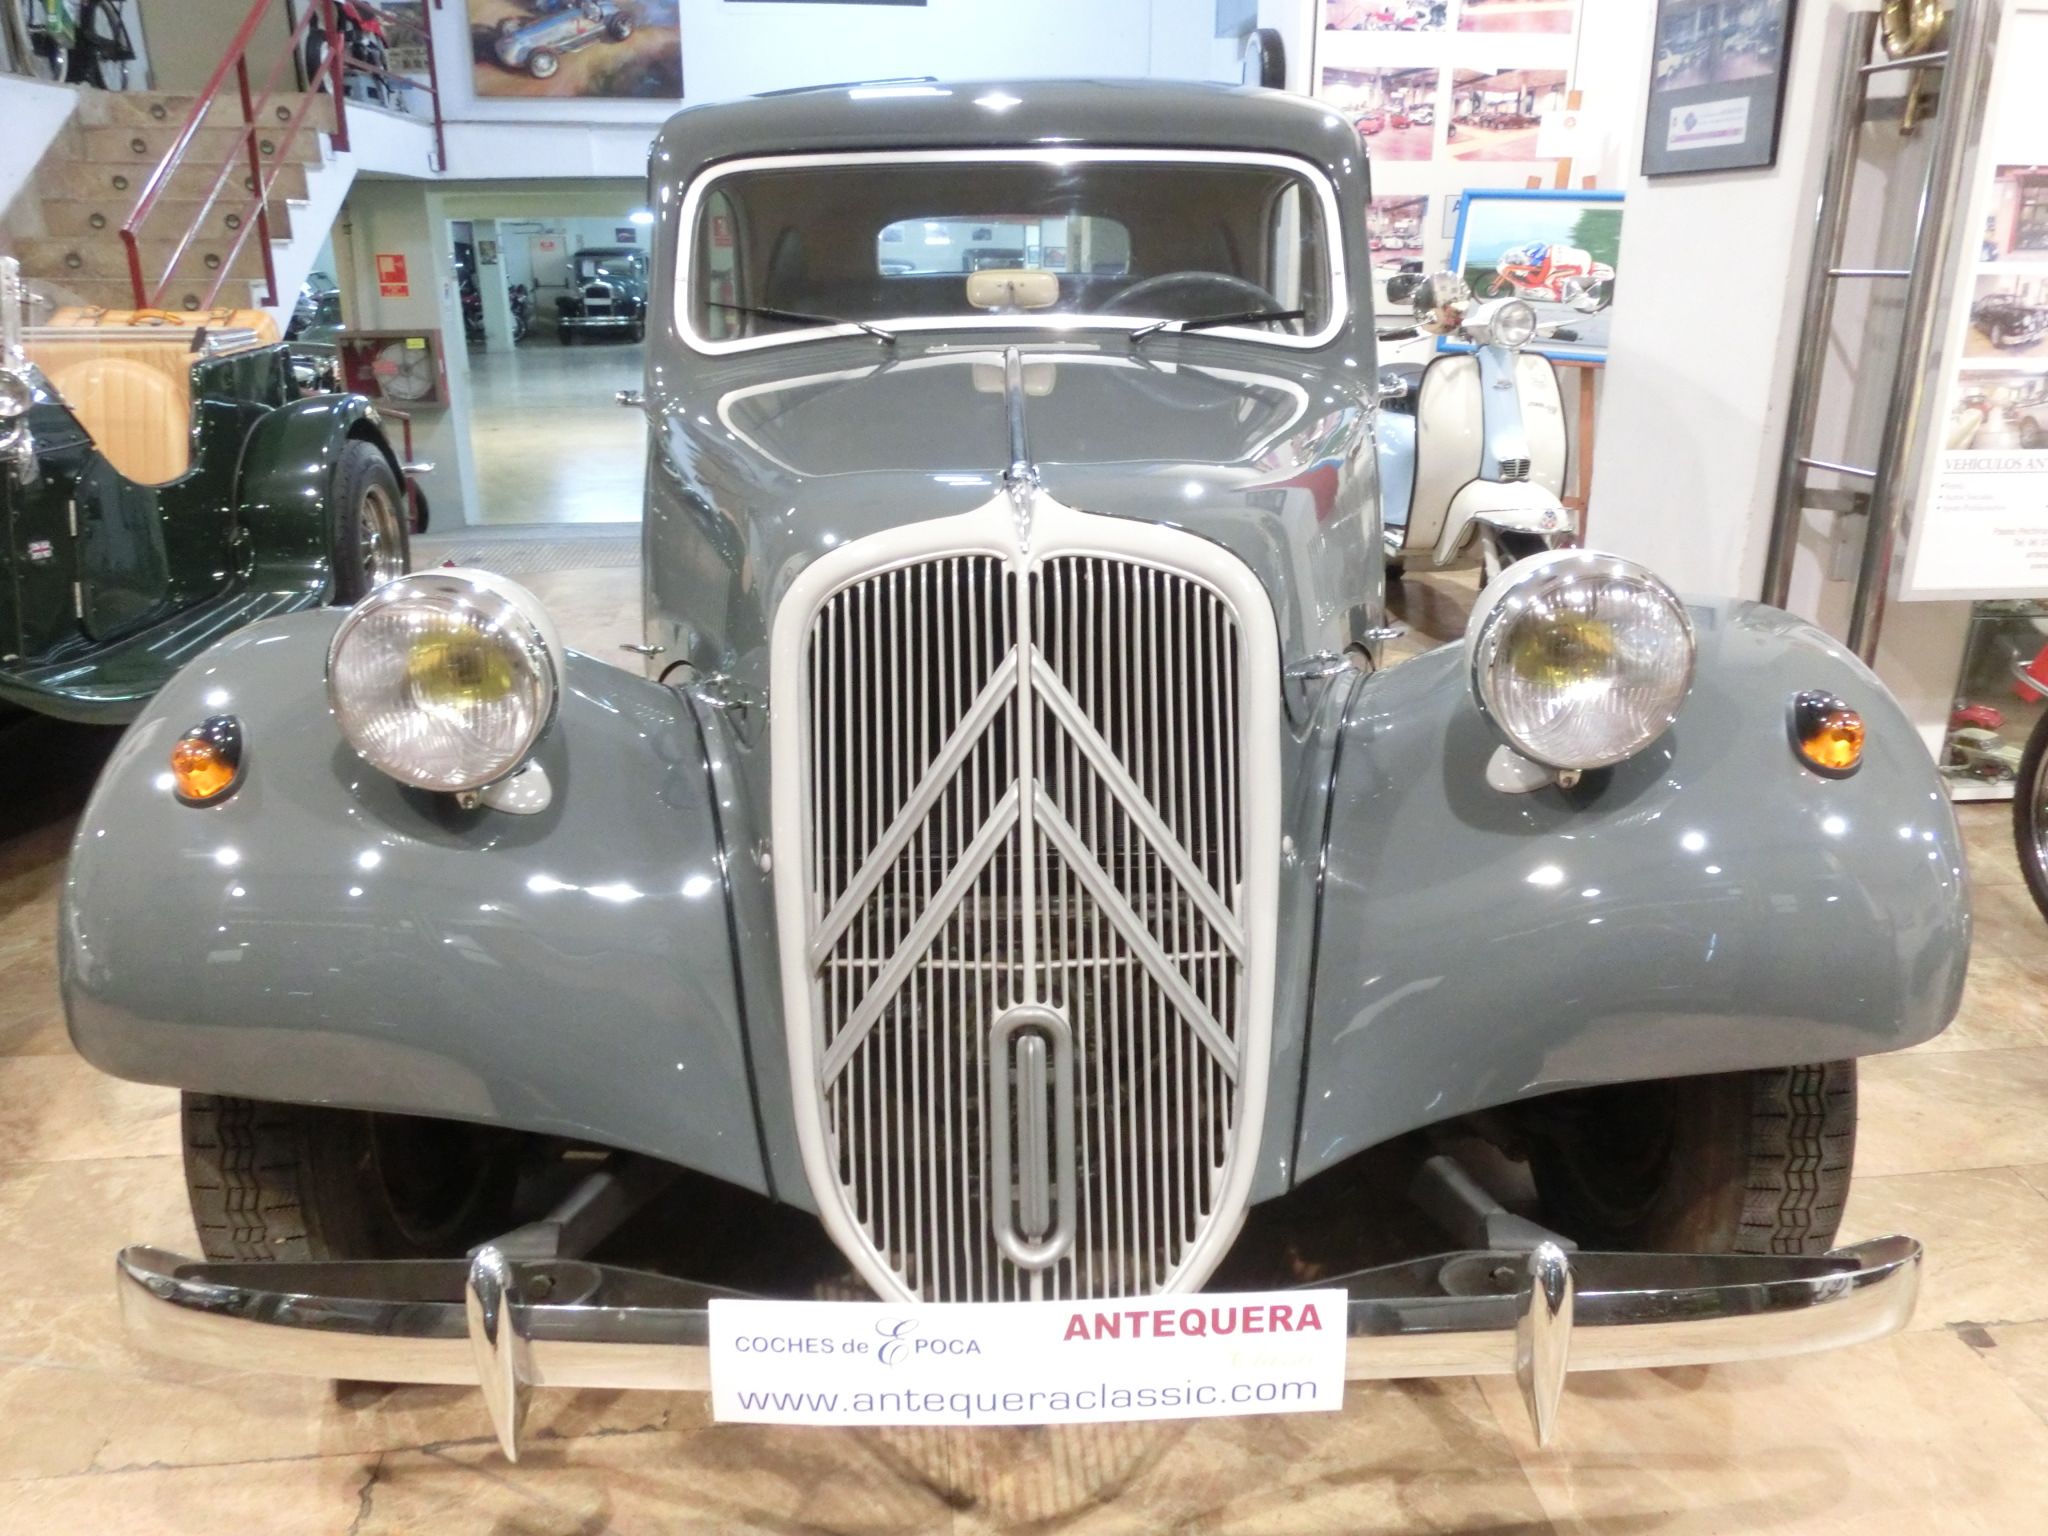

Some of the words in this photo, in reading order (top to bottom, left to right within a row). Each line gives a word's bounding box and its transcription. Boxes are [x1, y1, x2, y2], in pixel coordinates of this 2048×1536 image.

[1063, 1303, 1323, 1342] ANTEQUERA
[735, 1336, 834, 1354] COCHES
[842, 1339, 869, 1354] de
[737, 1379, 1319, 1419] www.antequeraclassic.com
